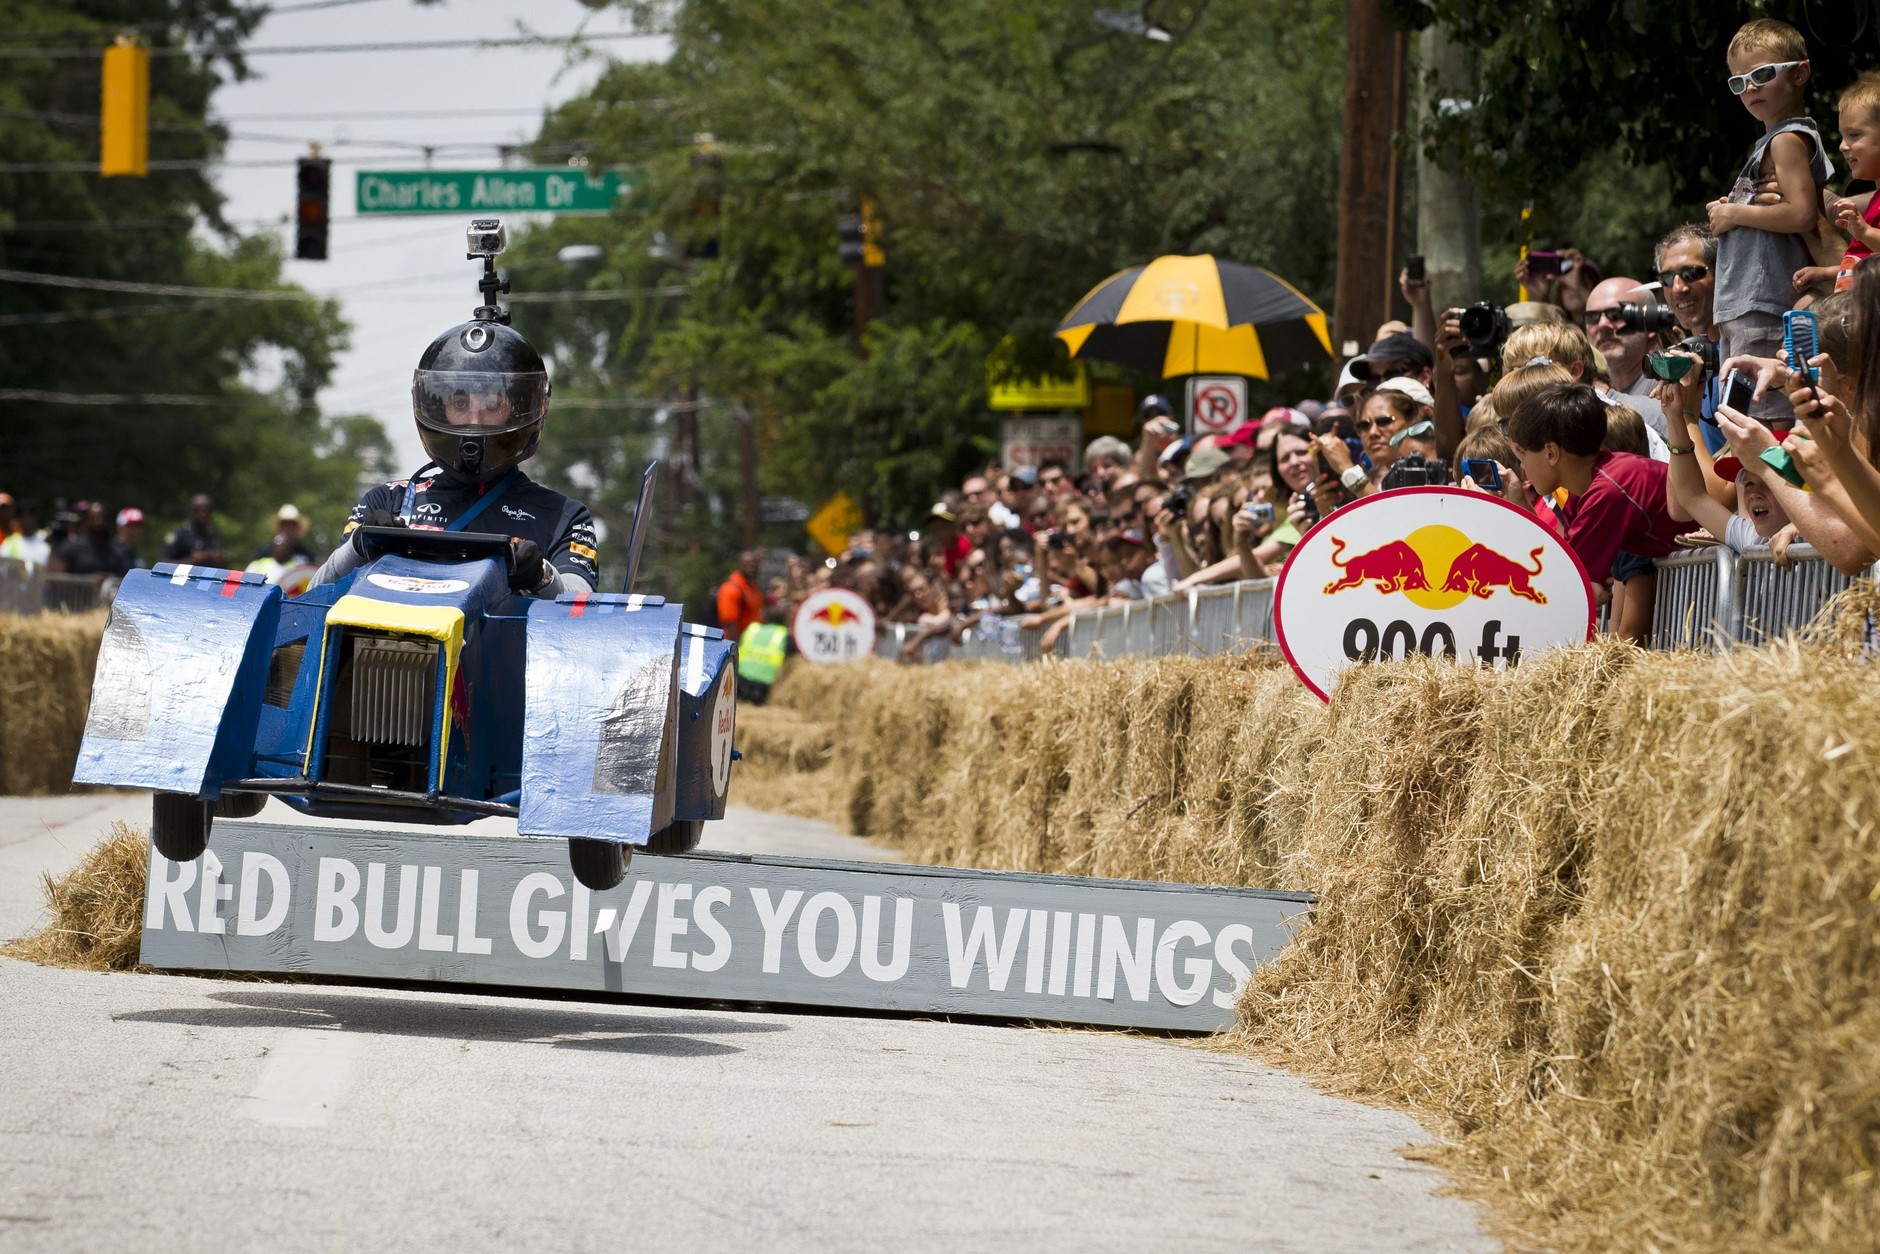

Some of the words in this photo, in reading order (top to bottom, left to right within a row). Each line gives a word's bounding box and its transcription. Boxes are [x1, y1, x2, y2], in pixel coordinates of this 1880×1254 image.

[361, 175, 460, 209] Charles
[471, 176, 536, 207] Allen
[545, 176, 577, 207] Dr
[146, 849, 290, 937] RED
[314, 857, 492, 955] BULL
[749, 886, 914, 982] YOU
[942, 902, 1254, 1010] WIIINGS
